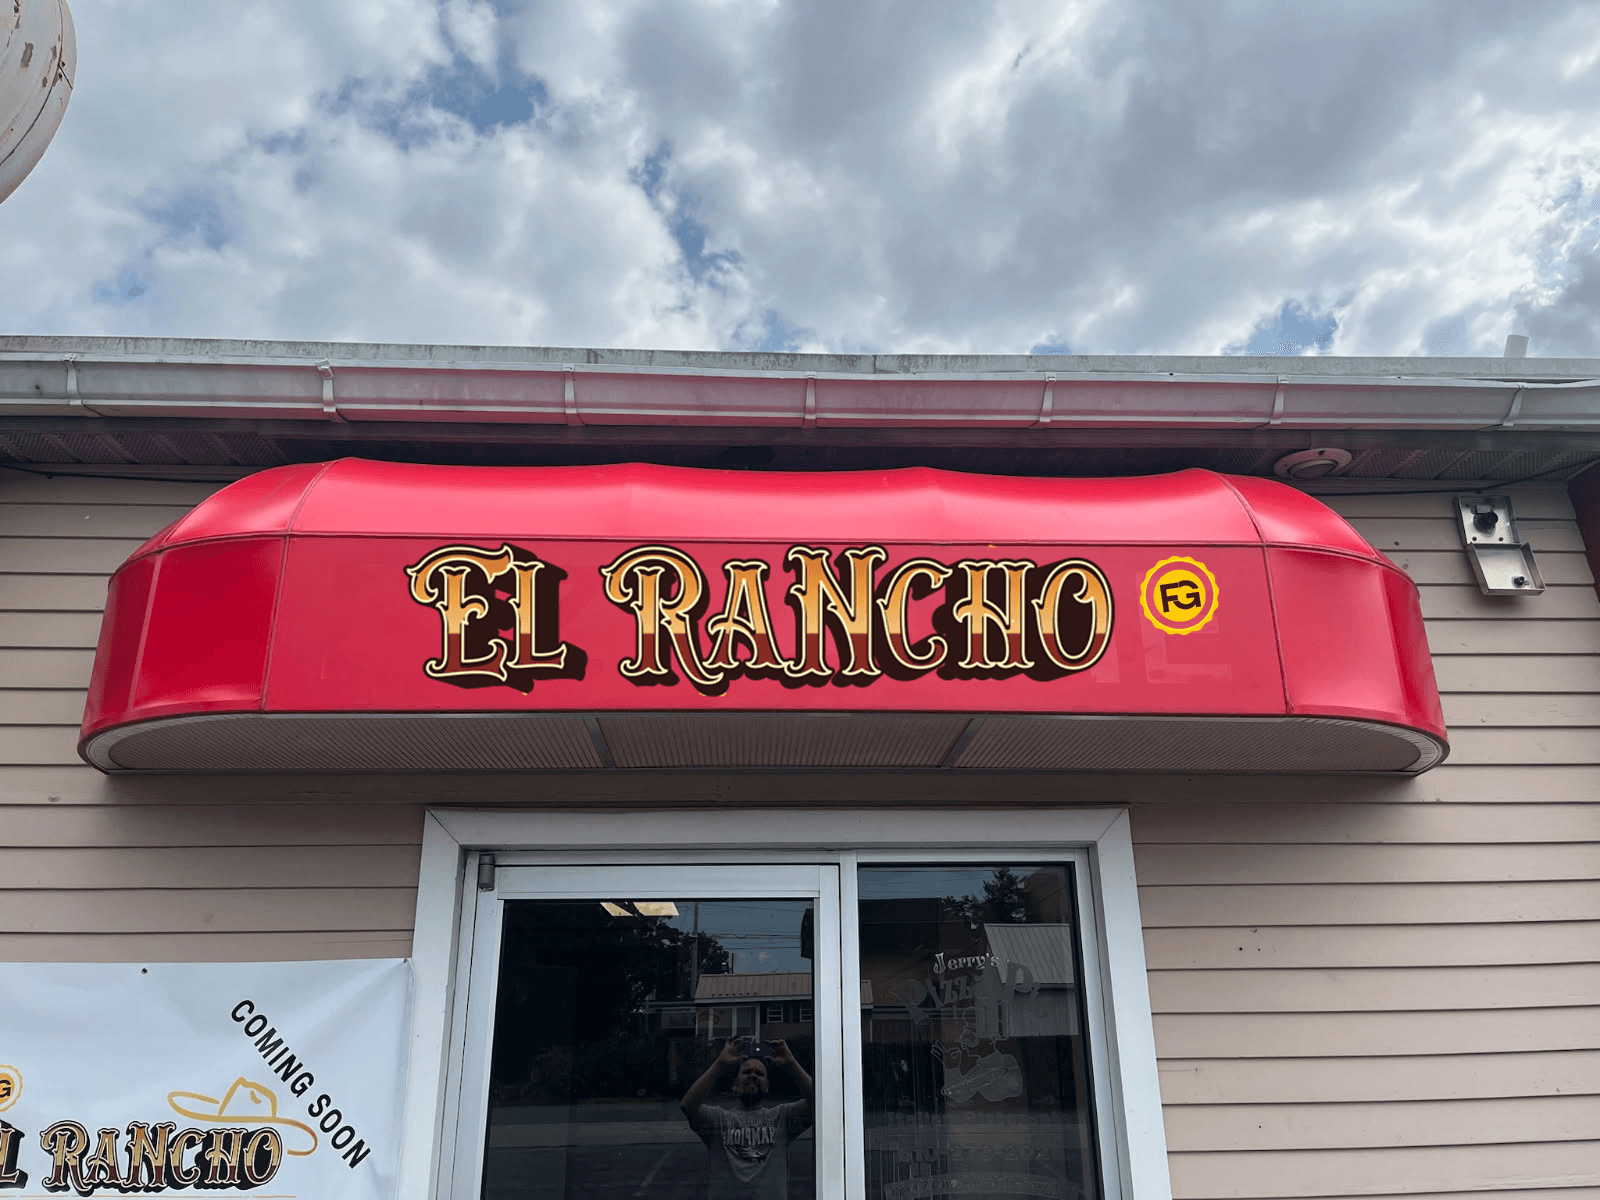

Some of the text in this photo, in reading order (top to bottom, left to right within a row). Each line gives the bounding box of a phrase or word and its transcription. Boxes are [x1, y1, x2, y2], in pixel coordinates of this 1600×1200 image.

[404, 543, 587, 692] EL
[599, 544, 1114, 695] RANCHO
[1160, 580, 1201, 612] FG
[933, 952, 1000, 973] Jerry's
[231, 1000, 371, 1169] COMING SOON
[0, 1120, 283, 1197] L RANCHO
